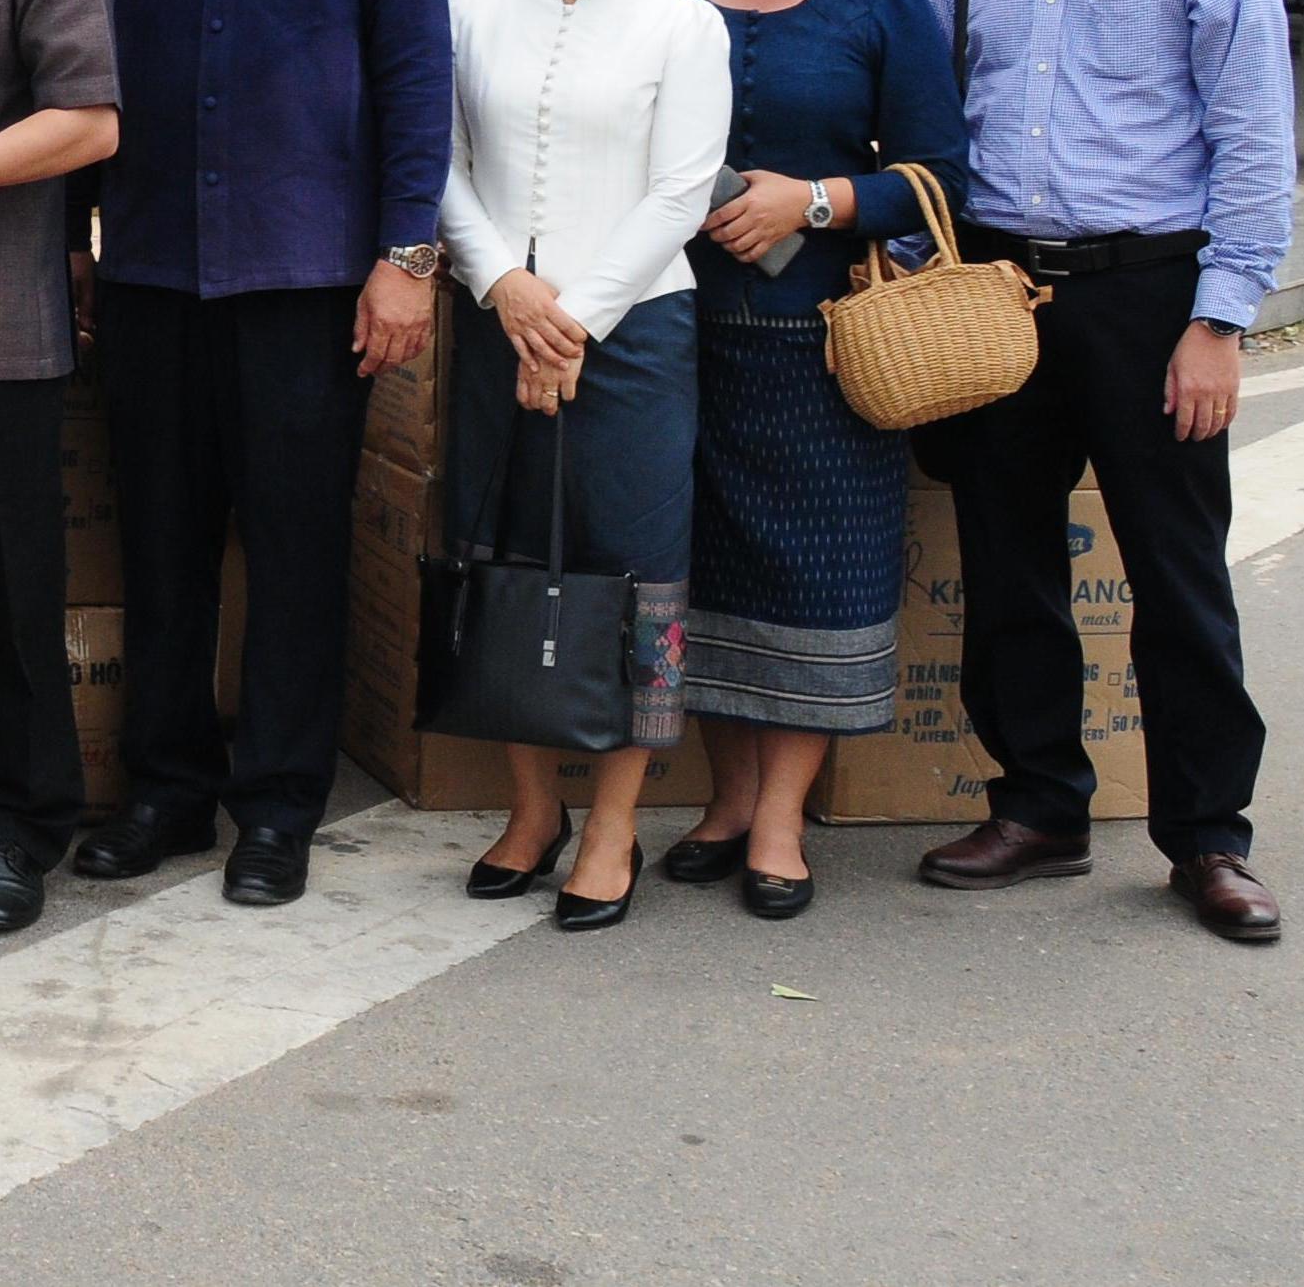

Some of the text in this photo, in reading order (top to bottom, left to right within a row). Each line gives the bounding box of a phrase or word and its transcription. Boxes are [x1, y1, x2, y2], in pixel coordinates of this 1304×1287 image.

[1080, 611, 1122, 627] mask
[904, 685, 942, 701] white
[1112, 715, 1127, 732] 50
